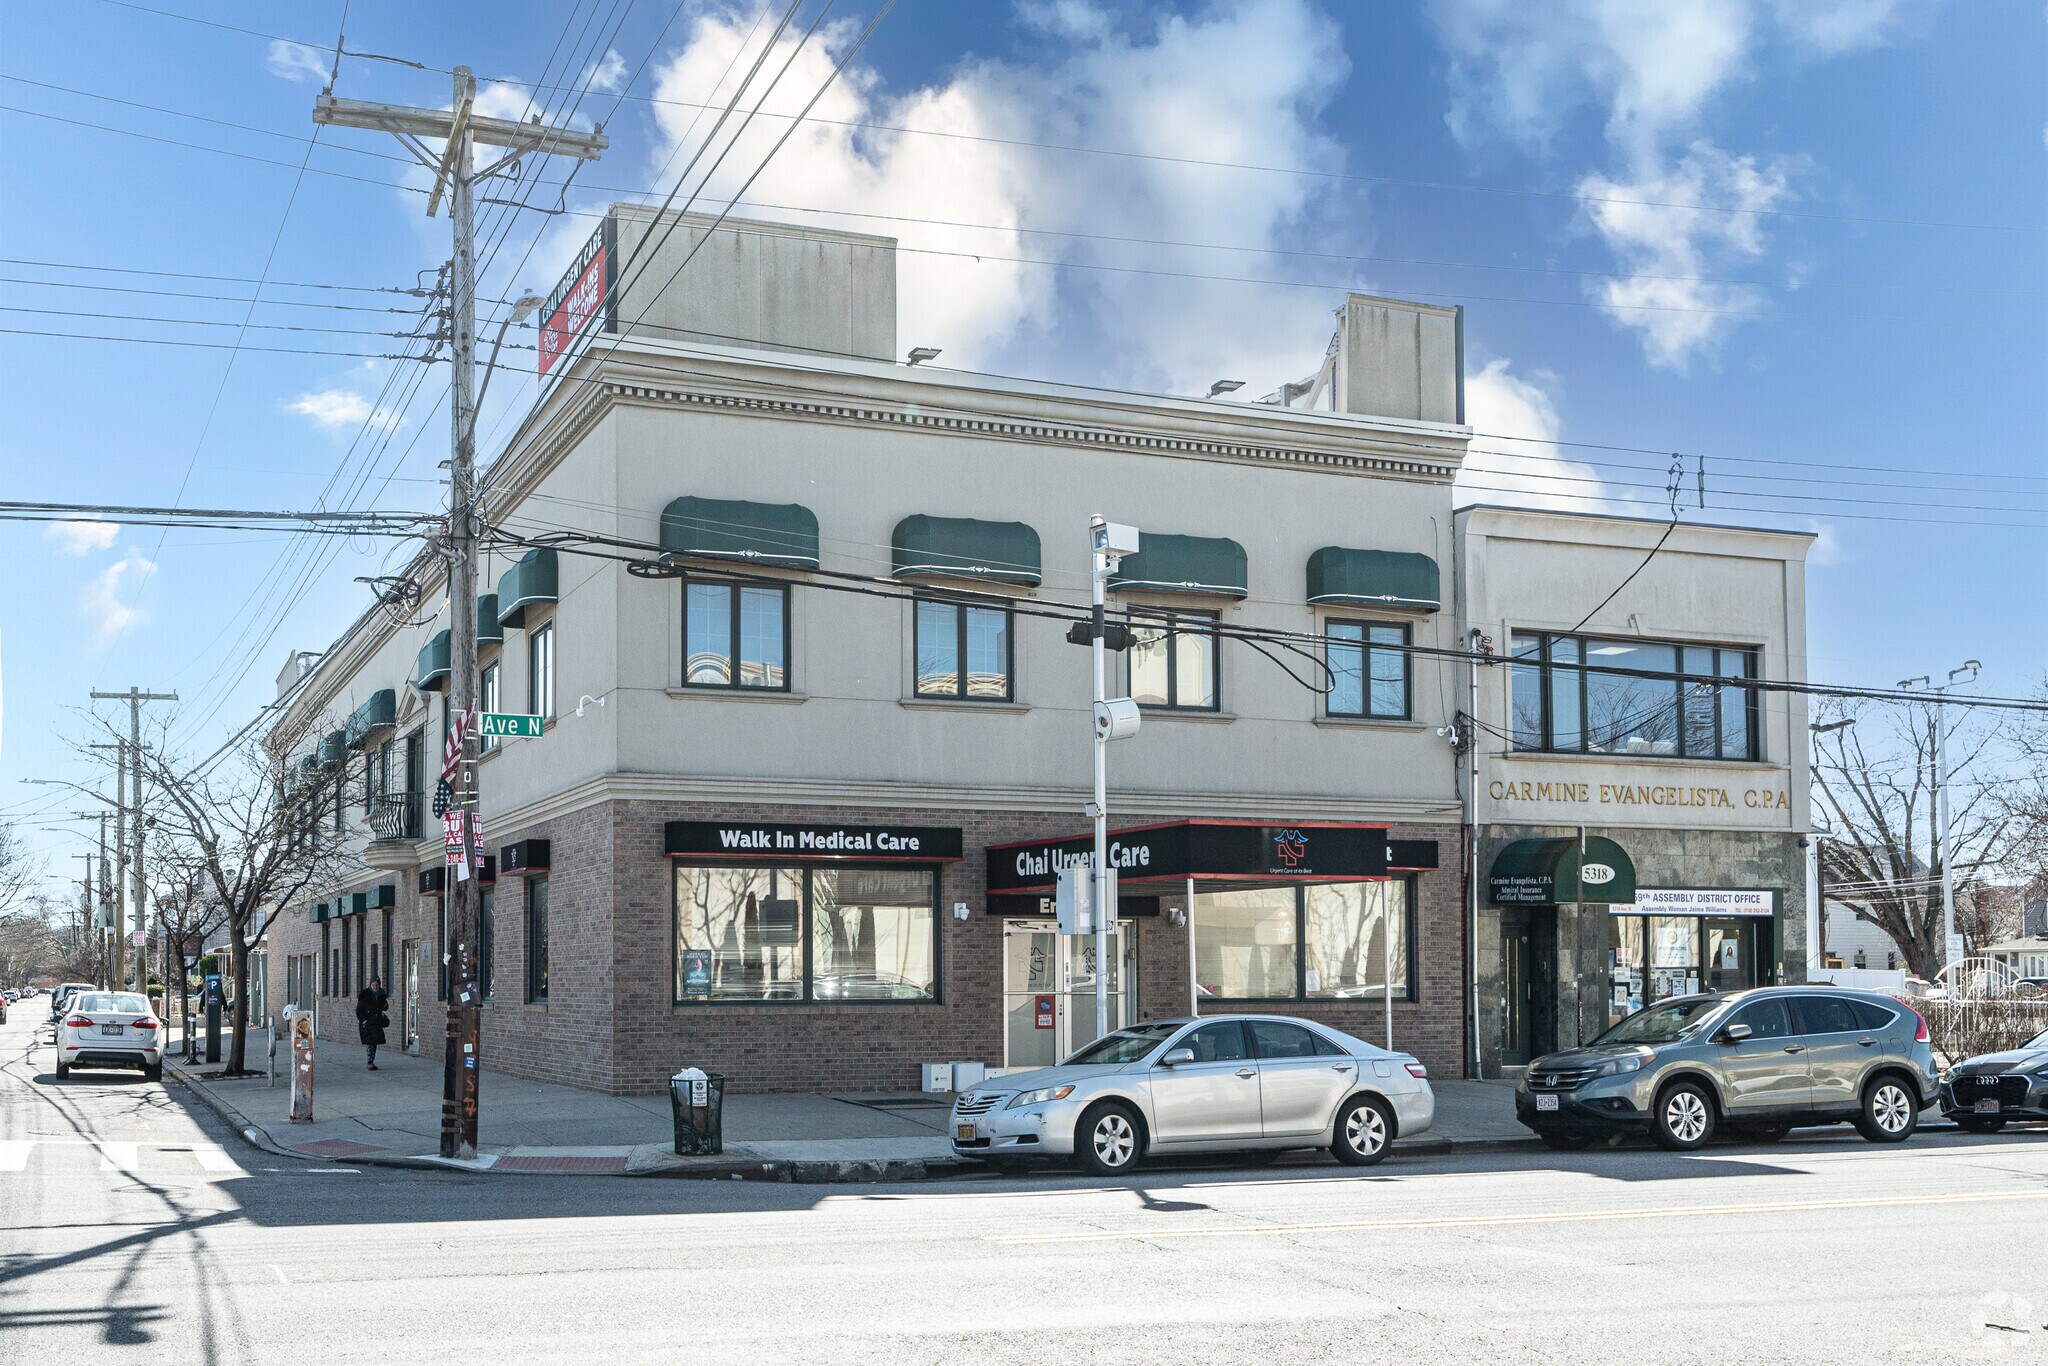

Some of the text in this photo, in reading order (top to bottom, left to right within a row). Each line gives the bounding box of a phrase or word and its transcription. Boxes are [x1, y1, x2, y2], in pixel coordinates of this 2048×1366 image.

[542, 228, 602, 324] CHAI URGENT CARE
[567, 263, 599, 312] WALK-INS
[567, 284, 598, 337] WELCOME
[484, 715, 540, 735] Ave N
[1489, 780, 1589, 802] CARMINE
[1600, 784, 1736, 809] EVANGELISTA,
[720, 830, 920, 851] Walk In Medical Care
[1016, 842, 1150, 876] Chai Urgen Care
[1491, 877, 1509, 885] Carmine
[1584, 867, 1608, 881] 5318
[1518, 894, 1546, 902] Management
[1653, 893, 1694, 903] ASSEMBLY
[1697, 894, 1733, 903] DISTRICT
[1734, 895, 1761, 904] OFFICE
[211, 981, 217, 989] P
